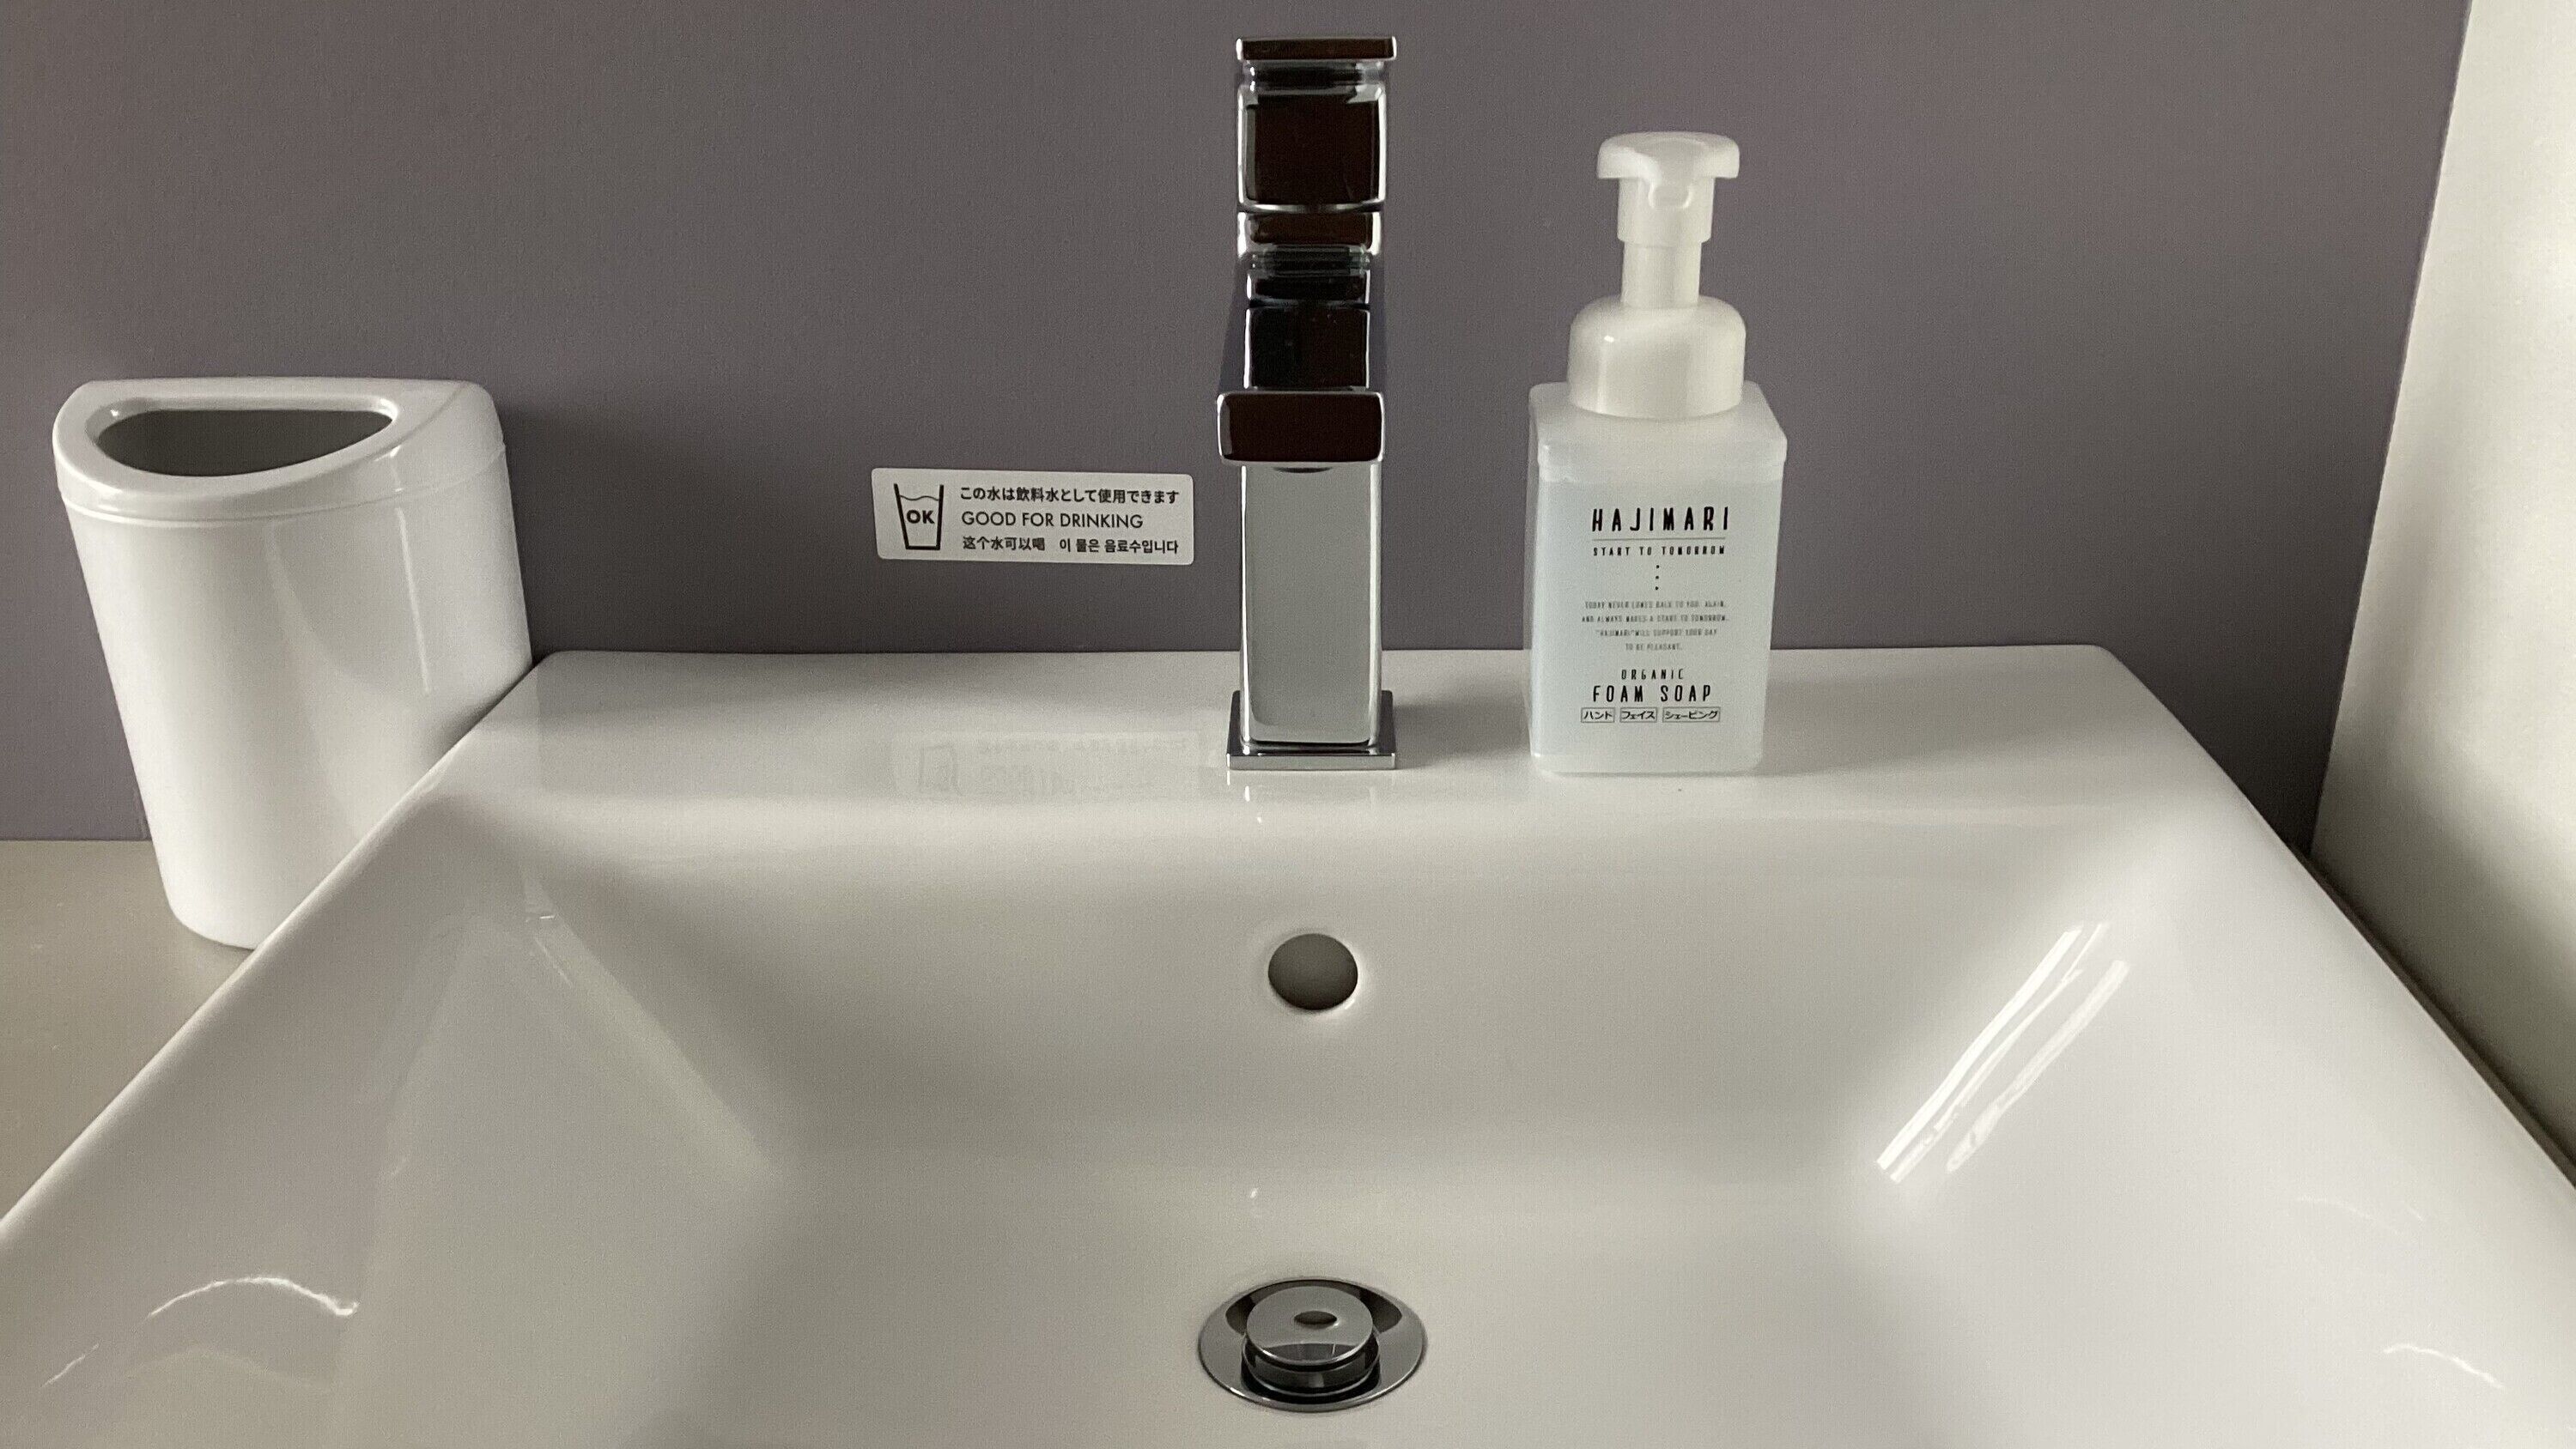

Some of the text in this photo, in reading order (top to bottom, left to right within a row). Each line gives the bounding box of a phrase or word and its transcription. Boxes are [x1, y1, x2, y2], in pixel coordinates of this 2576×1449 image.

[960, 486, 1180, 505] この水は飲料水として使用できます
[906, 509, 935, 524] OK
[961, 511, 1144, 529] GOOD FOR DRINKING
[1592, 506, 1728, 531] HAJIMARI
[963, 535, 1046, 551] 这个水可以喝
[1059, 537, 1180, 555] 이 물은 음료수입니다
[1593, 545, 1725, 556] START TO TOMORROW
[1621, 668, 1684, 680] ORGANIC
[1593, 685, 1711, 702] FOAM SOAP
[1583, 709, 1719, 720] ハンド フェイス シェービング
